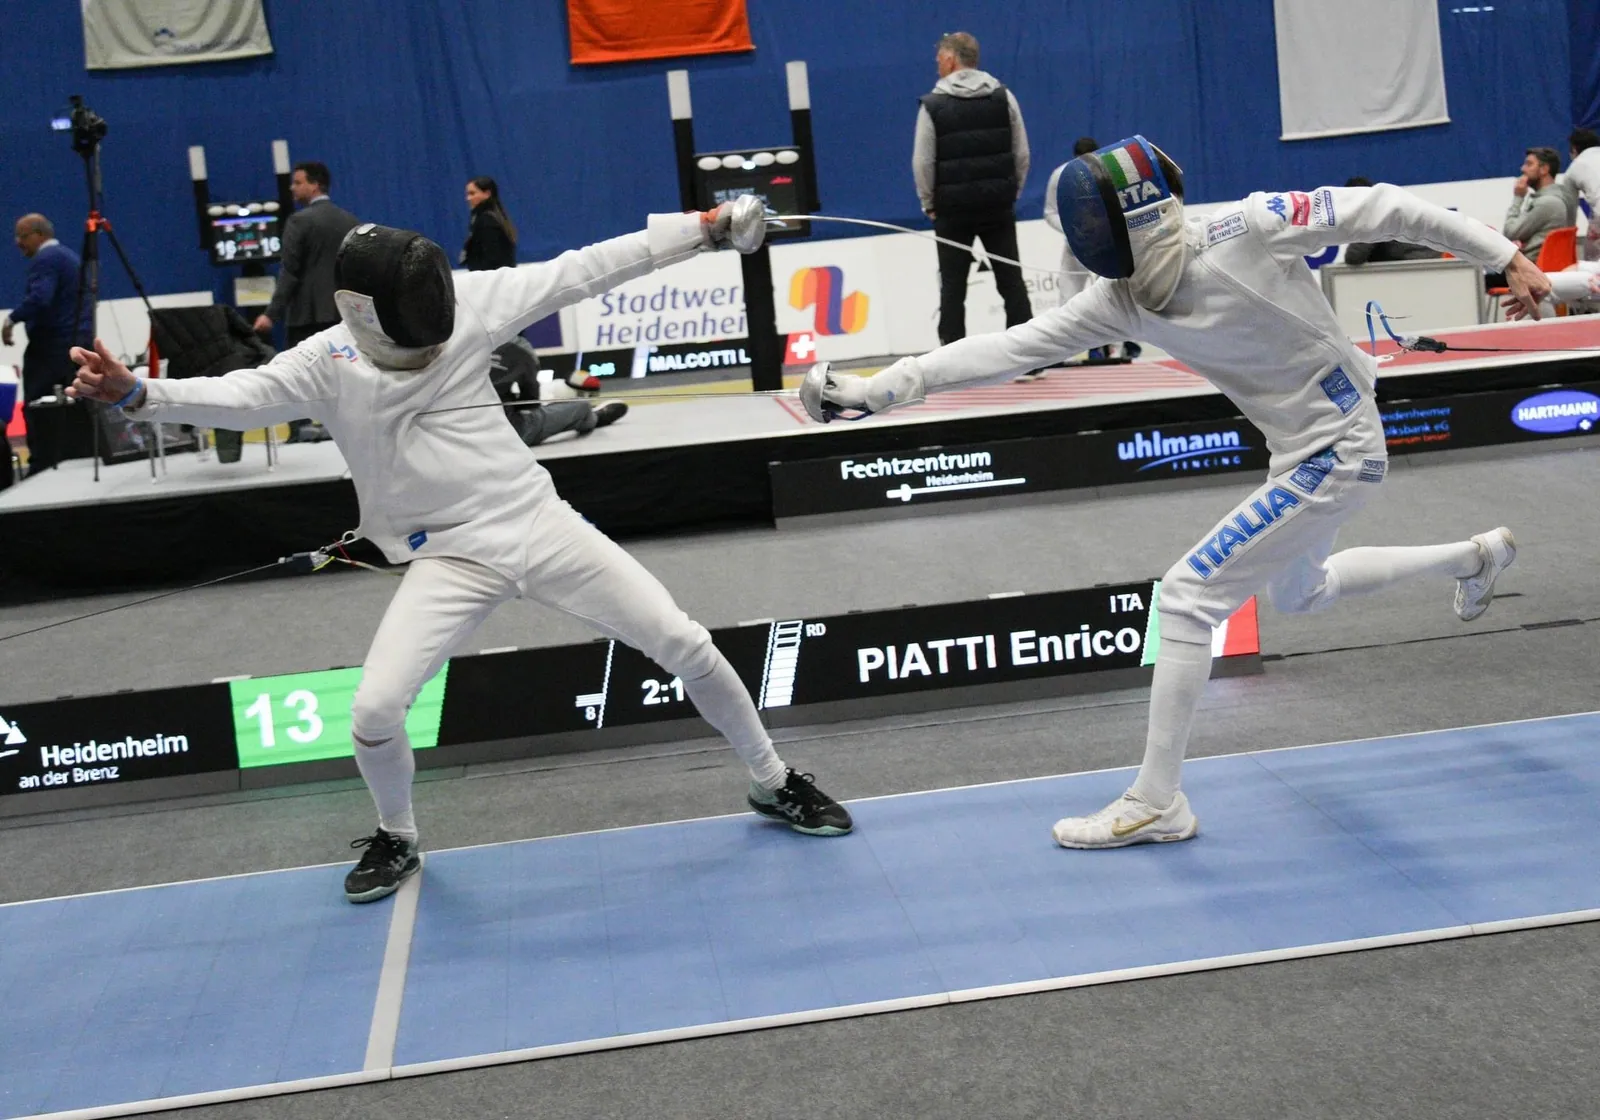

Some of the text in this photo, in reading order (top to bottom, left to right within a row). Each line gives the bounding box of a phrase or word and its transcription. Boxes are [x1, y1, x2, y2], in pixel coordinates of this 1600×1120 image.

[1117, 180, 1161, 209] ITA
[600, 284, 740, 316] Stadtwer
[596, 308, 746, 346] Heidenhei
[649, 350, 737, 373] MALCOTTI
[1380, 407, 1451, 421] eidenheimer
[1518, 401, 1598, 421] HARTMANN
[1384, 421, 1431, 436] olksbank
[1117, 430, 1240, 461] uhlmann
[840, 451, 992, 480] Fechtzentrum
[925, 471, 994, 487] Heidenheim
[1186, 486, 1301, 580] ITALIA
[1110, 593, 1143, 613] ITA
[806, 623, 826, 637] RD
[857, 624, 1141, 683] PIATTI Enrico
[641, 676, 685, 705] 2:1
[245, 689, 324, 748] 13
[40, 733, 190, 768] Heidenheim
[18, 766, 120, 789] an der Brenz
